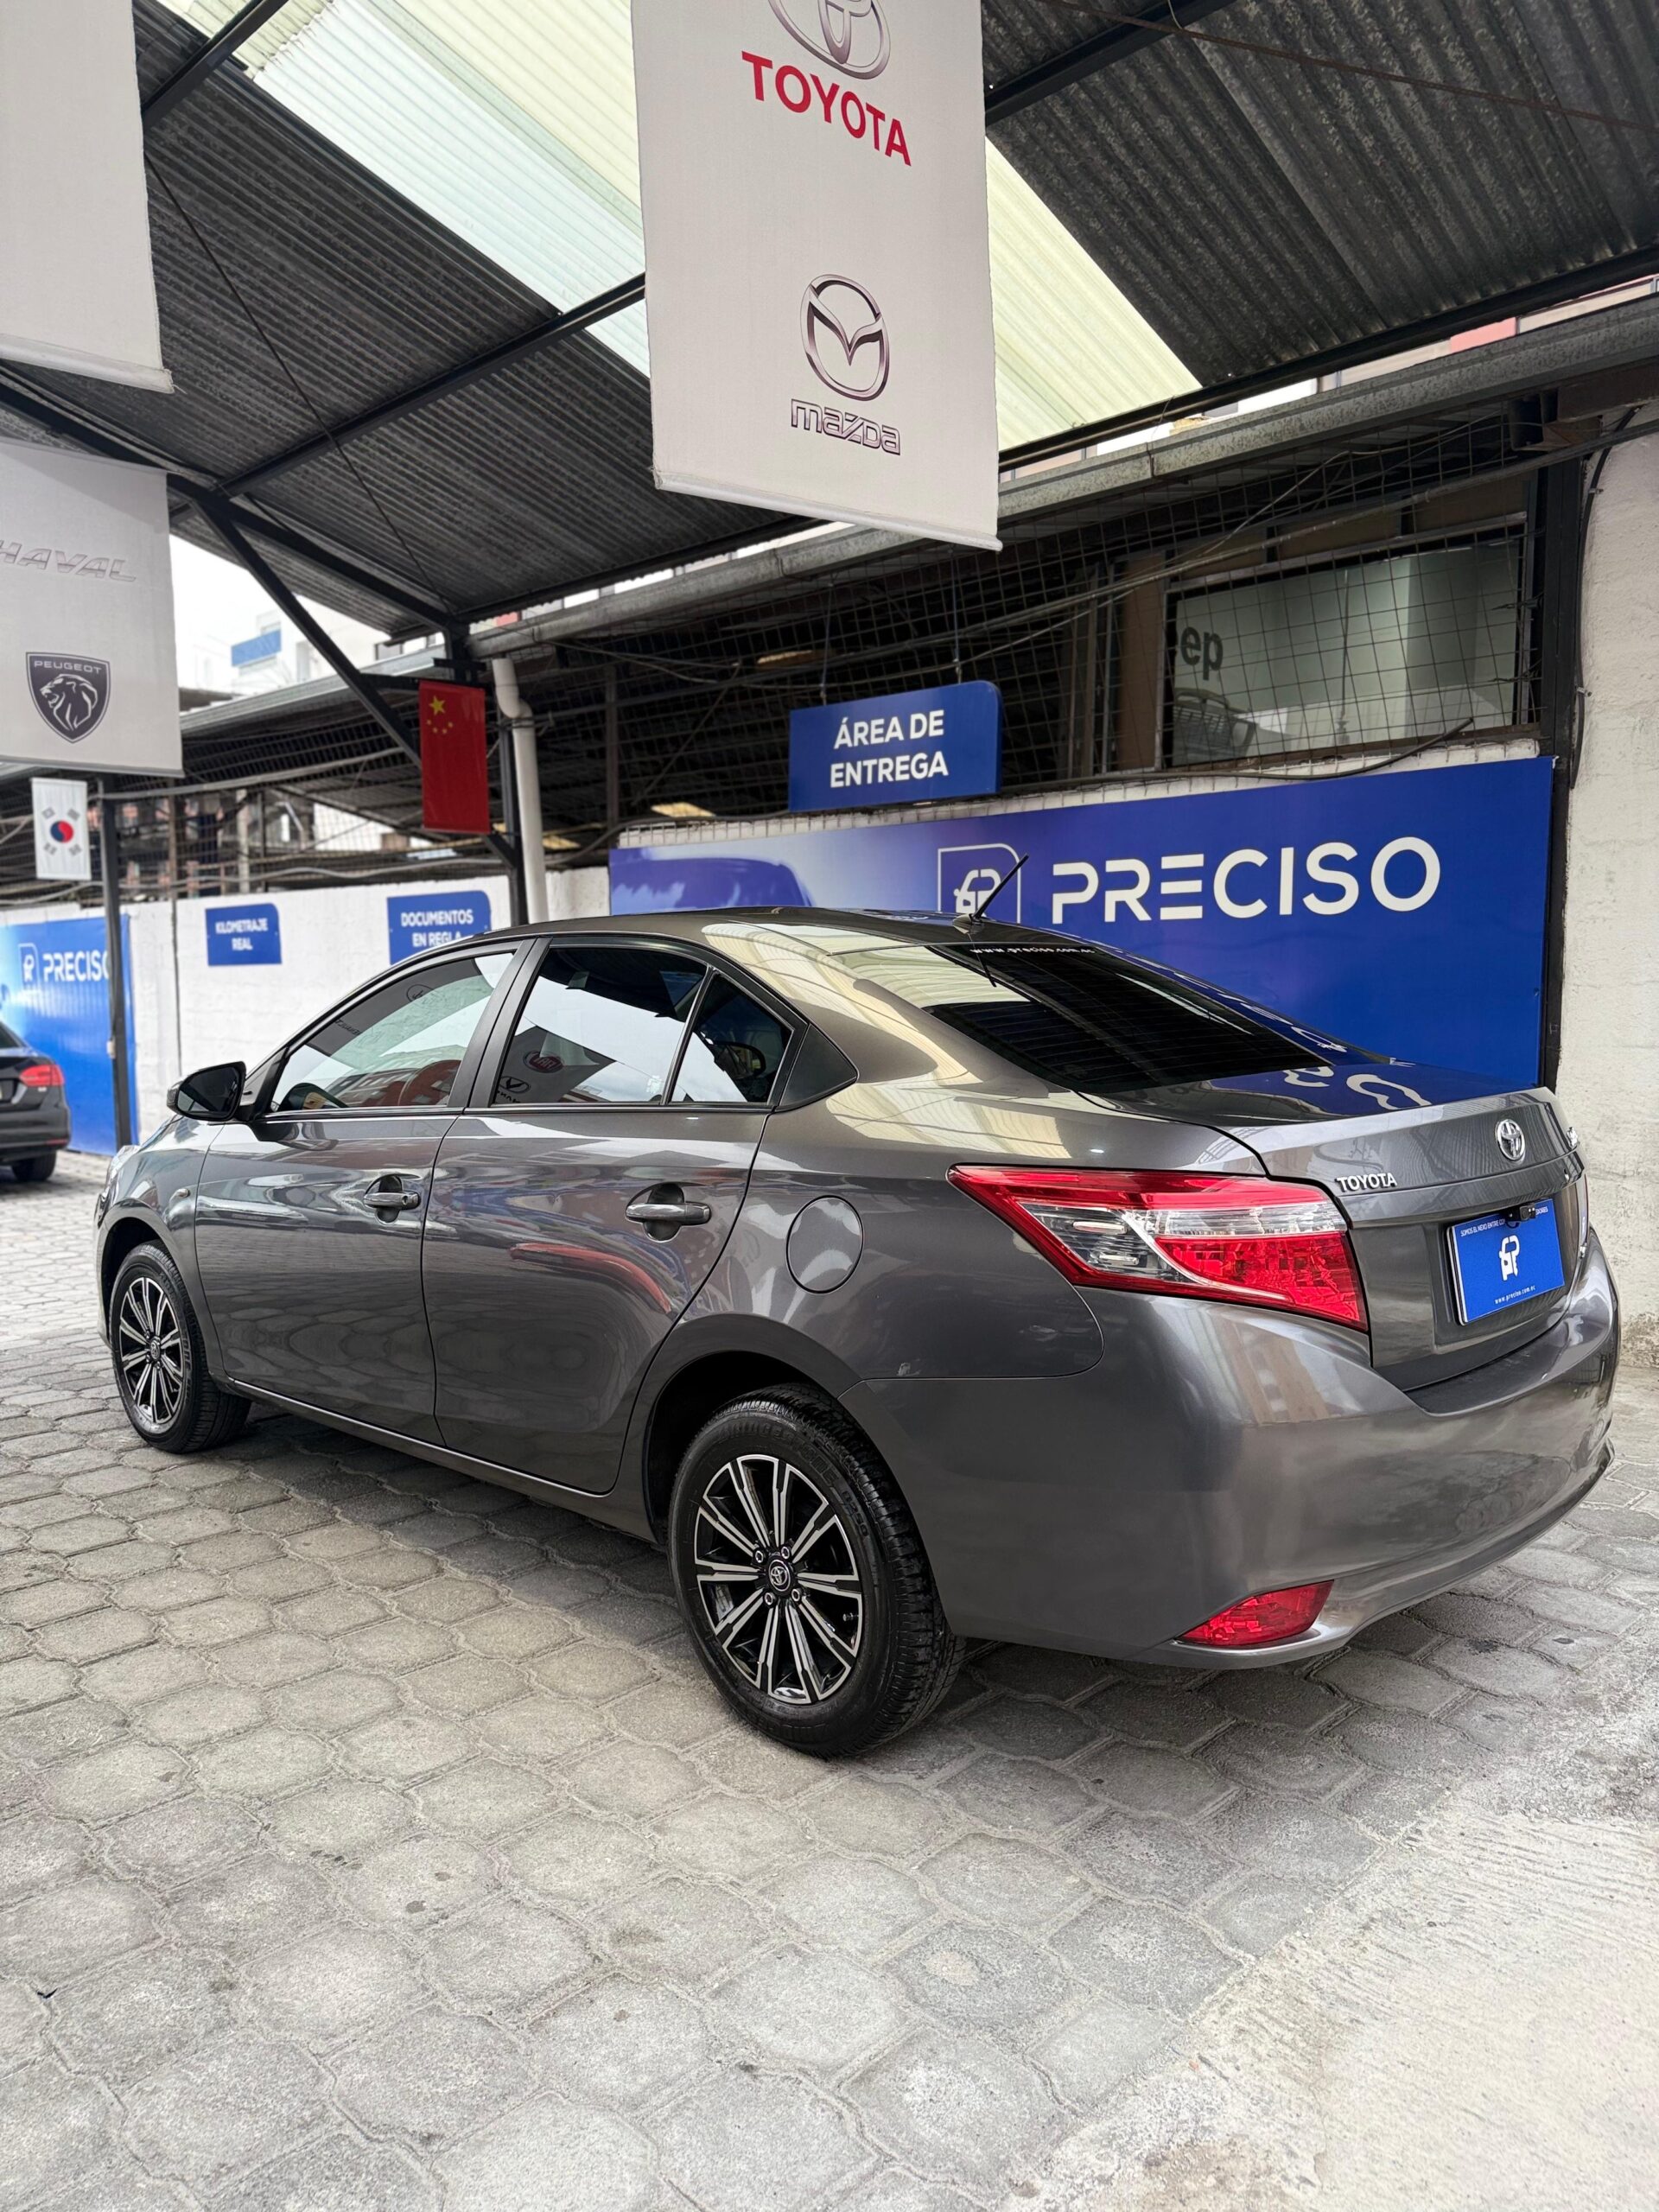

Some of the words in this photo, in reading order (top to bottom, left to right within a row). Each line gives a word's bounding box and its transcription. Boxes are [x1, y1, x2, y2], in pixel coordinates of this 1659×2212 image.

[741, 50, 912, 167] TOYOTA
[791, 398, 900, 455] mazda
[0, 540, 137, 582] HAVAL
[34, 660, 102, 675] PEUGEOT
[1175, 626, 1224, 681] ep
[834, 717, 904, 749] ÁREA
[910, 709, 944, 740] DE
[830, 751, 949, 788] ENTREGA
[1052, 836, 1440, 925] PRECISO
[215, 918, 269, 934] KILOMETRAJE
[401, 909, 474, 927] DOCUMENTOS
[232, 938, 253, 951] REAL
[412, 932, 427, 947] EN
[1336, 1172, 1397, 1193] TOYOTA
[1488, 1219, 1499, 1229] ENTRE
